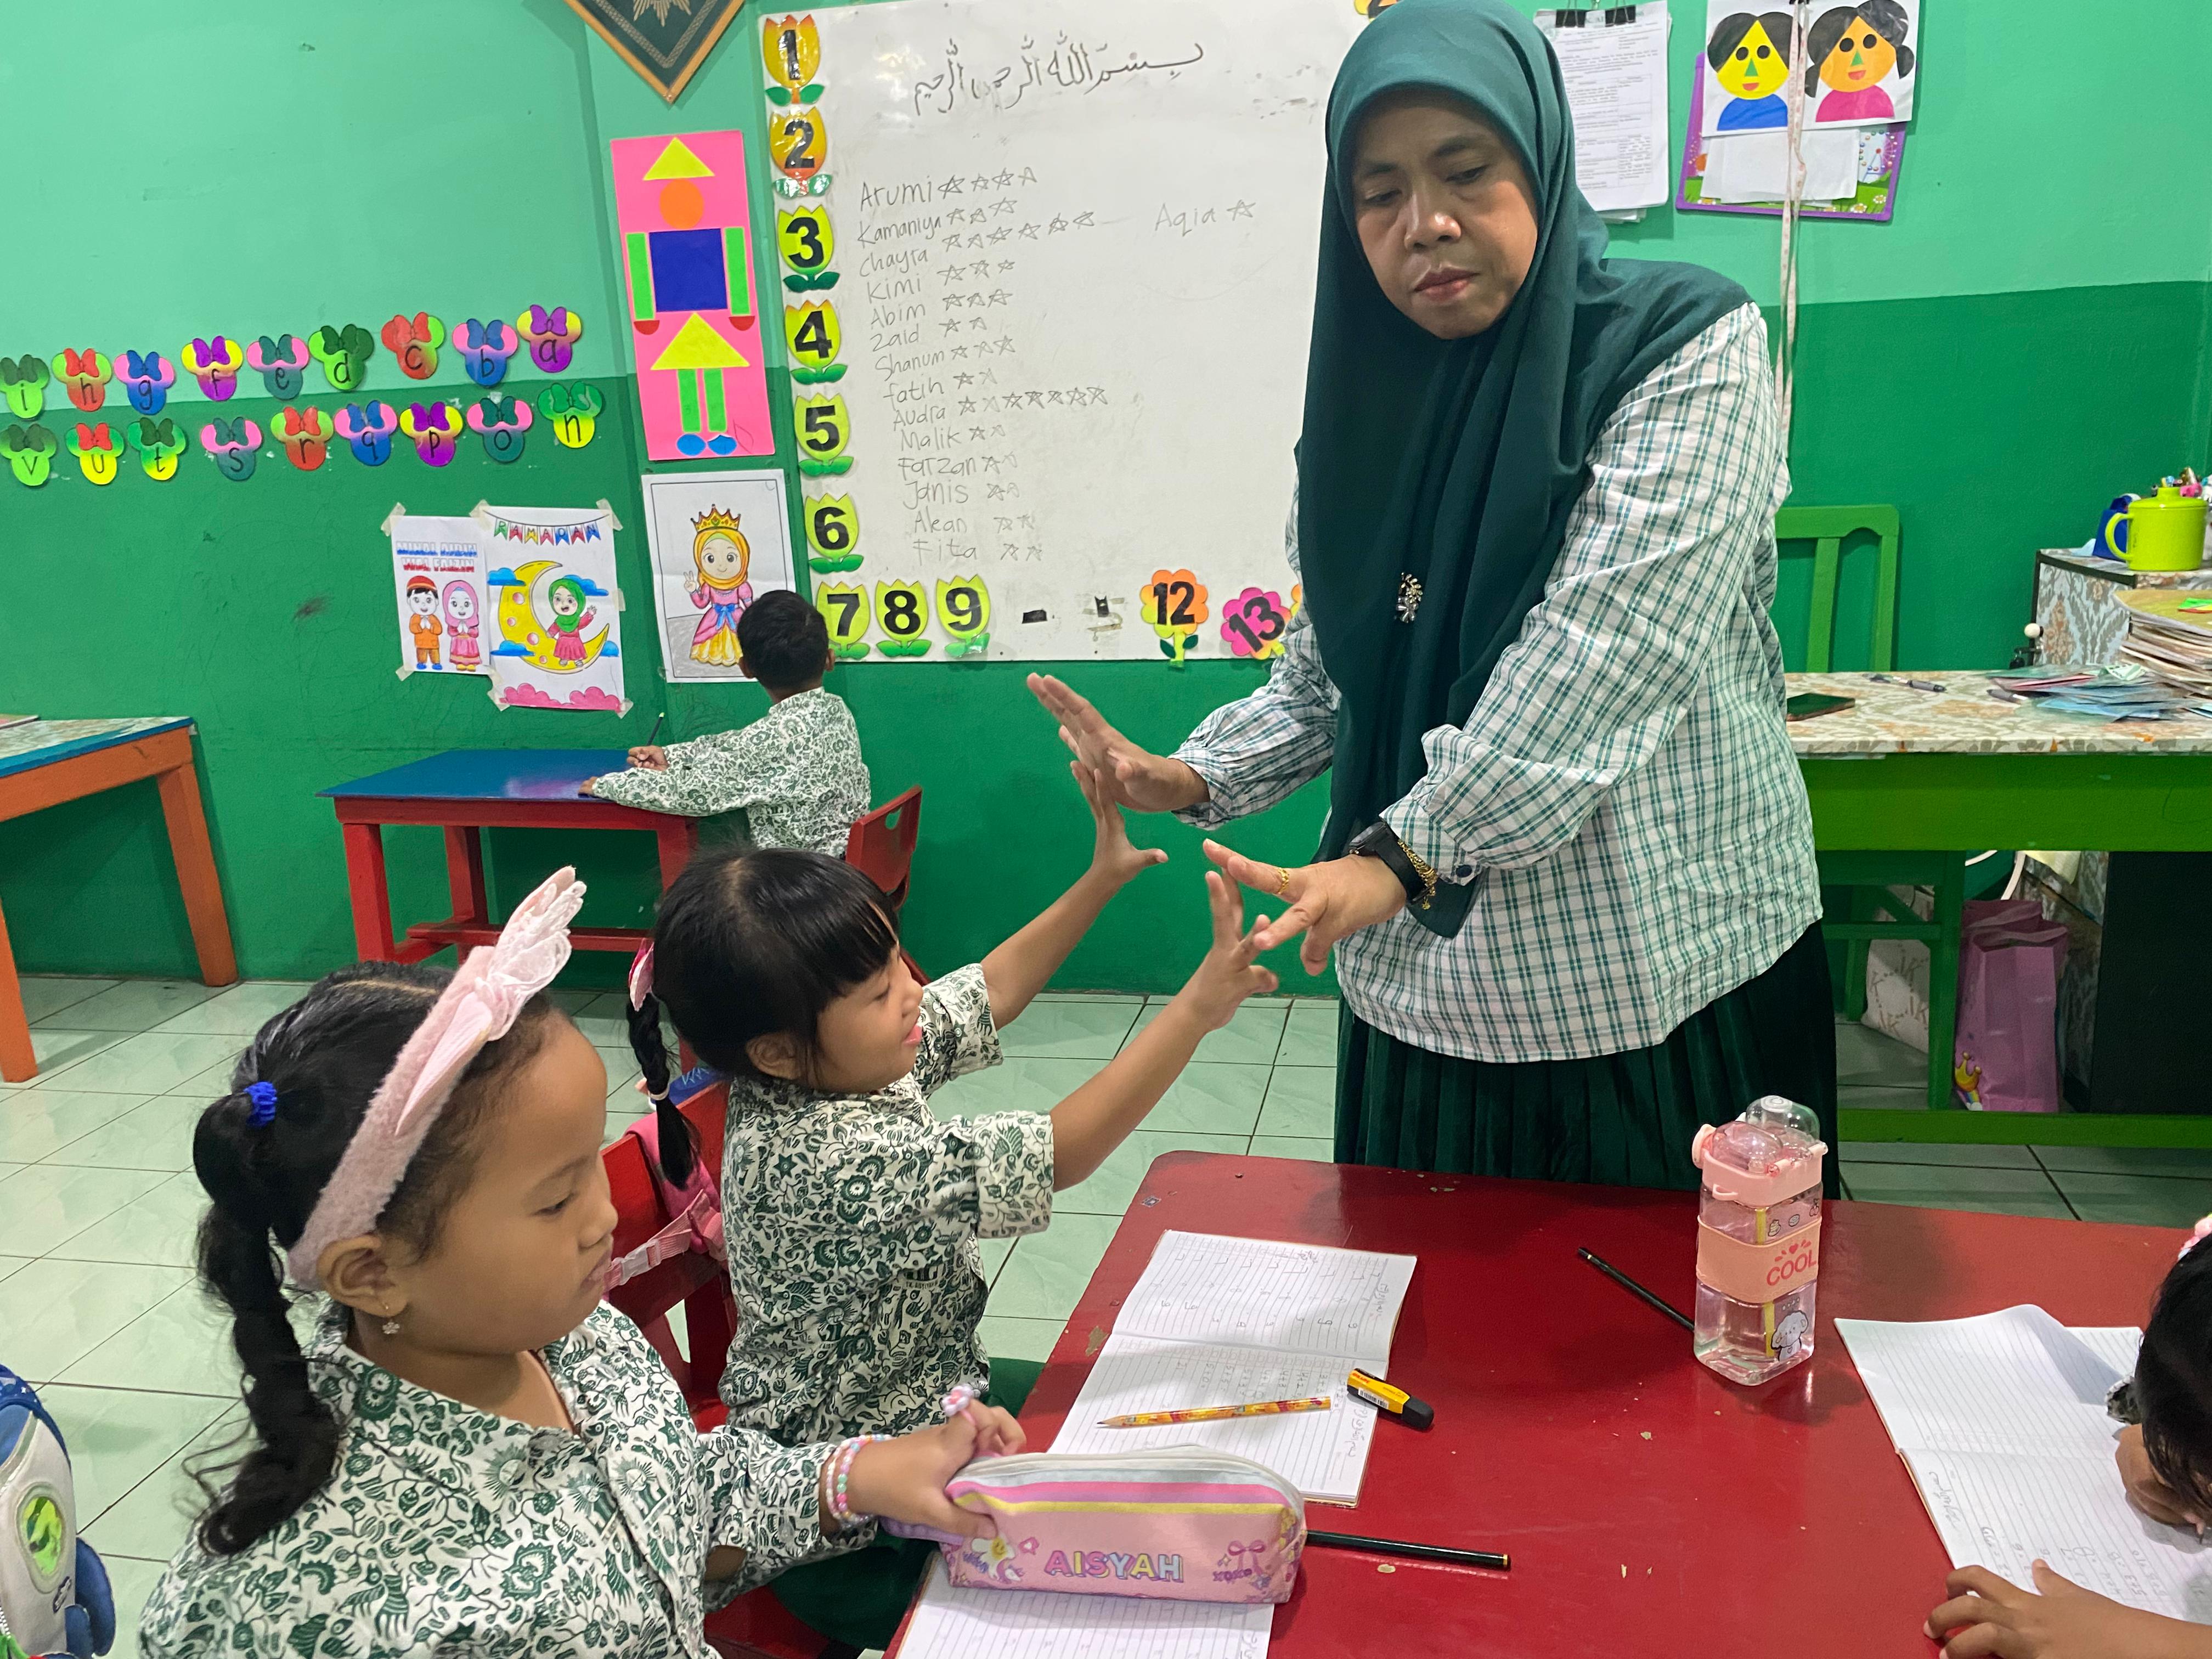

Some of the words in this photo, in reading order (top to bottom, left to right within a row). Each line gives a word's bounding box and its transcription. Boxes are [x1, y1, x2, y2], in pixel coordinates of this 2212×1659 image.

[778, 29, 798, 82] 1
[782, 119, 815, 170] 2
[860, 175, 933, 212] Arumi
[787, 216, 823, 269] 3
[793, 309, 833, 360] 4
[871, 303, 926, 330] Abim
[80, 377, 97, 406] h
[138, 379, 154, 410] g
[275, 367, 290, 391] e
[333, 353, 351, 384] d
[481, 348, 495, 377] b
[539, 339, 558, 363] a
[154, 447, 165, 472] t
[299, 438, 315, 464] r
[361, 430, 380, 462] q
[563, 414, 582, 443] n
[805, 404, 840, 452] 5
[900, 426, 962, 452] Malik
[903, 479, 969, 510] Janis
[498, 520, 596, 537] RAMADAN
[814, 506, 850, 550] 6
[827, 593, 860, 636] 7
[884, 589, 921, 635] 8
[947, 586, 983, 630] 9
[1153, 581, 1195, 625] 12
[1228, 596, 1285, 653] 13
[1767, 1249, 1817, 1286] COOL
[1044, 1550, 1184, 1583] AISYAH
